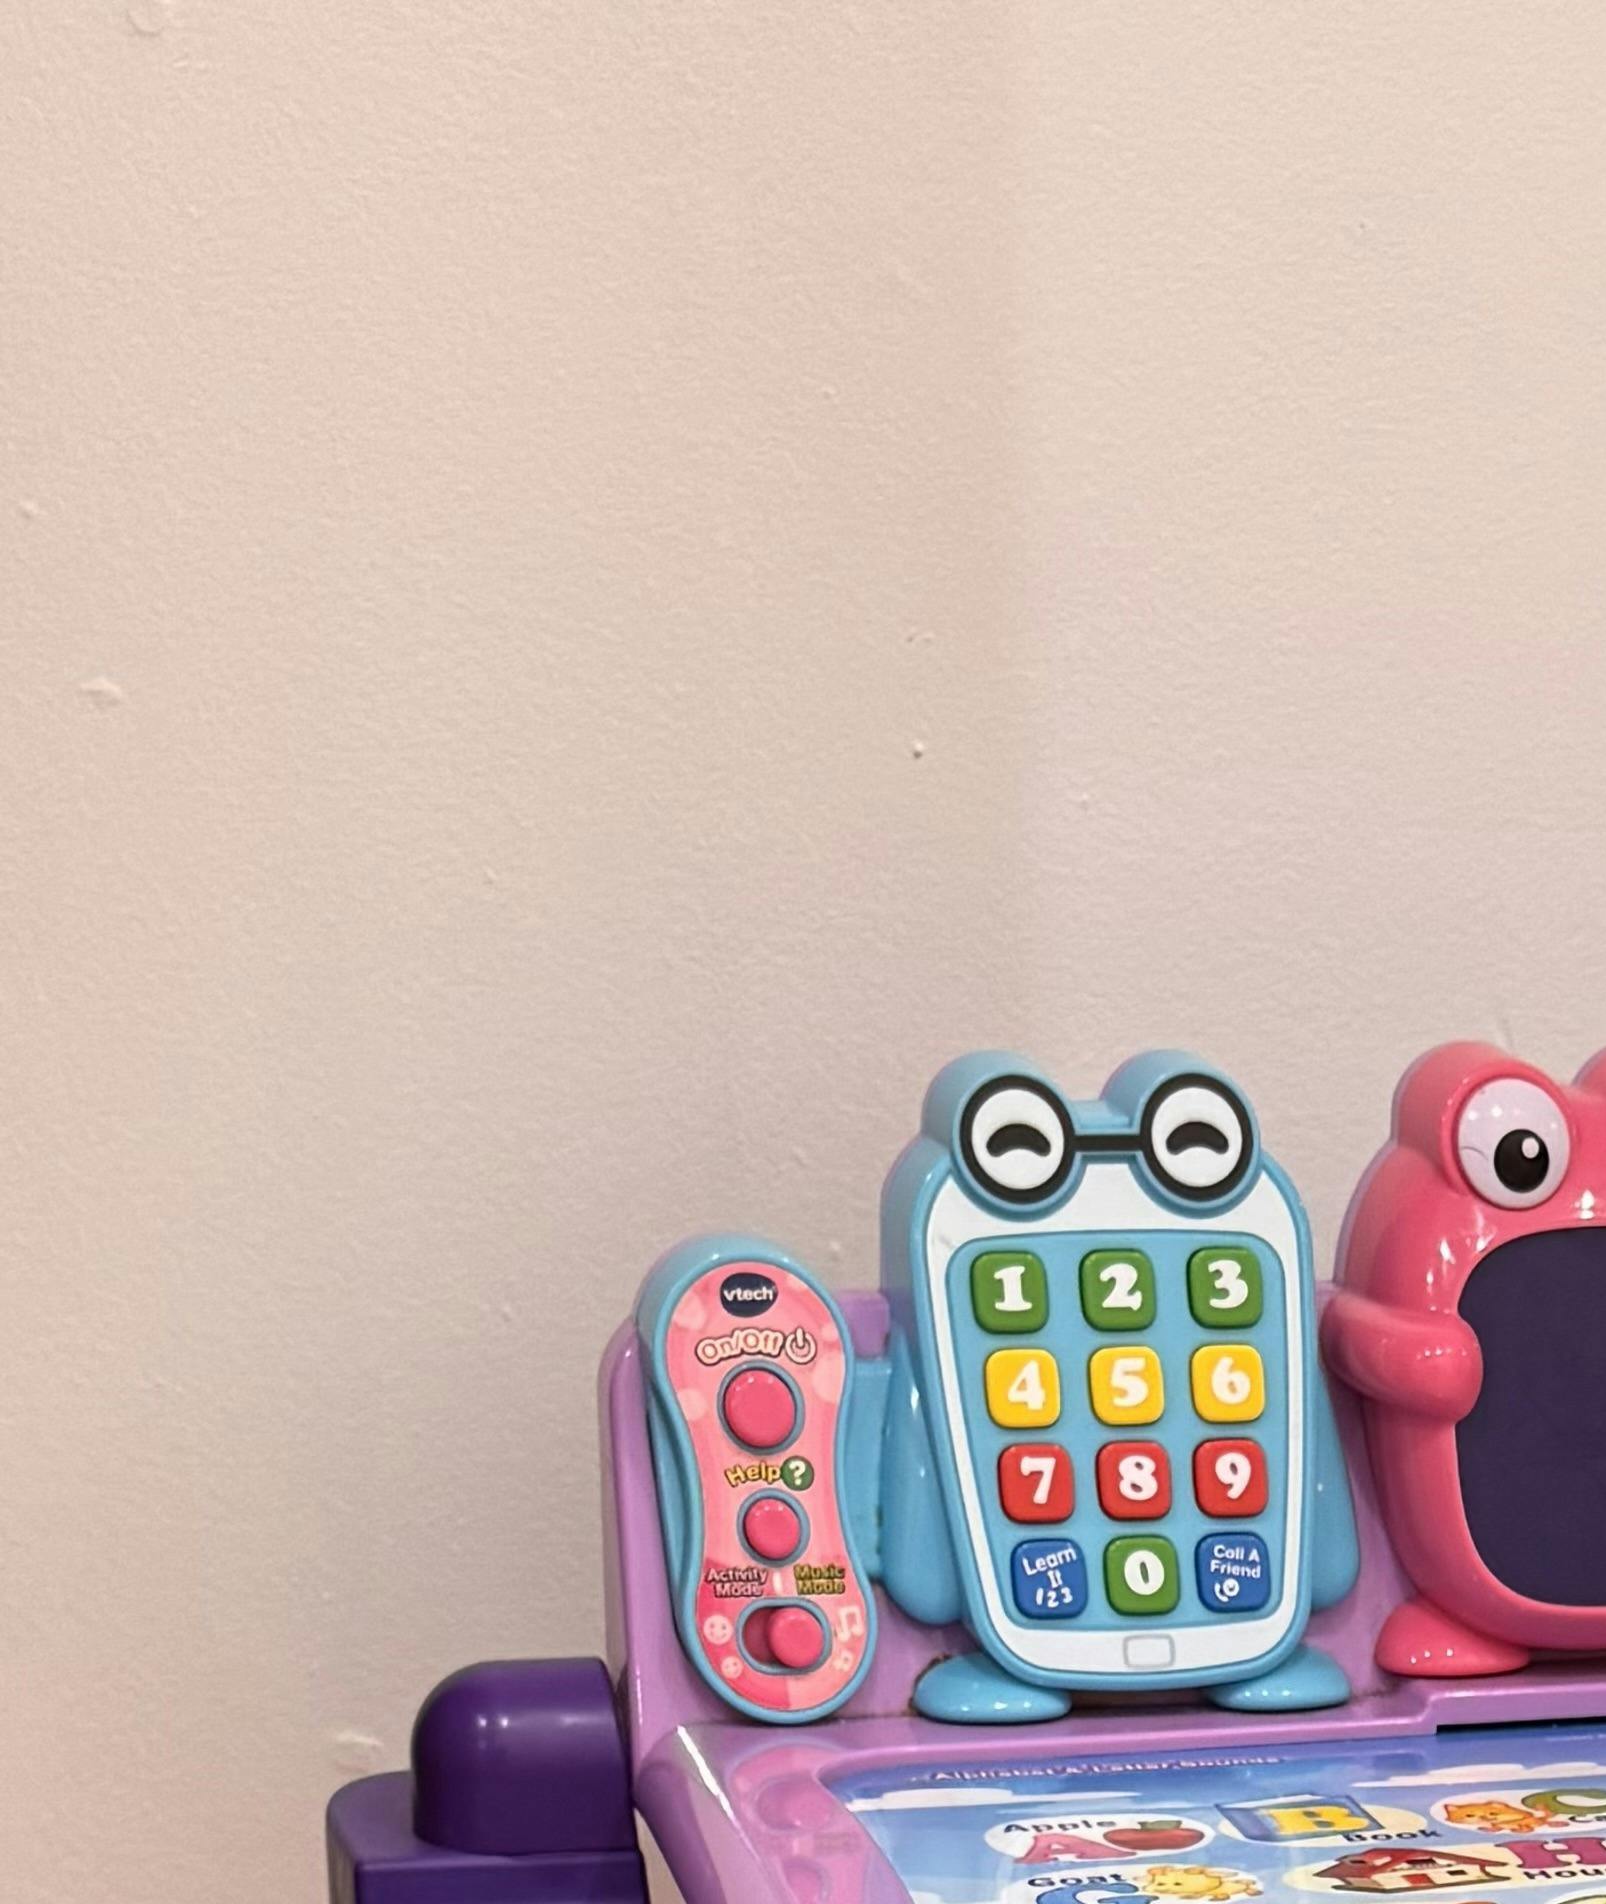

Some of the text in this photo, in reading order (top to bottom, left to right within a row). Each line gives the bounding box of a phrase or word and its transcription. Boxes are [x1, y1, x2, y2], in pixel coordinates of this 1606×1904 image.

[724, 1286, 773, 1301] vtech
[994, 1266, 1033, 1311] 1
[1099, 1263, 1142, 1310] 2
[1207, 1260, 1249, 1309] 3
[696, 1327, 784, 1366] On/Off
[1008, 1360, 1045, 1410] 4
[1111, 1357, 1148, 1408] 5
[1211, 1356, 1250, 1404] 6
[725, 1462, 781, 1487] Help
[1020, 1456, 1056, 1504] 7
[1119, 1455, 1158, 1500] 8
[1215, 1452, 1251, 1499] 9
[1022, 1547, 1077, 1575] Learn
[1210, 1560, 1261, 1578] Friend
[1248, 1548, 1260, 1562] A
[706, 1567, 768, 1584] Activity
[794, 1564, 845, 1579] Music
[1049, 1570, 1062, 1588] It
[1124, 1550, 1165, 1595] 0
[715, 1582, 763, 1597] Mode
[798, 1580, 845, 1595] Mode
[1003, 1820, 1116, 1833] Apple
[1270, 1806, 1369, 1835] B
[1014, 1833, 1137, 1864] A
[1343, 1829, 1442, 1842] Book
[1028, 1873, 1127, 1887] Goat
